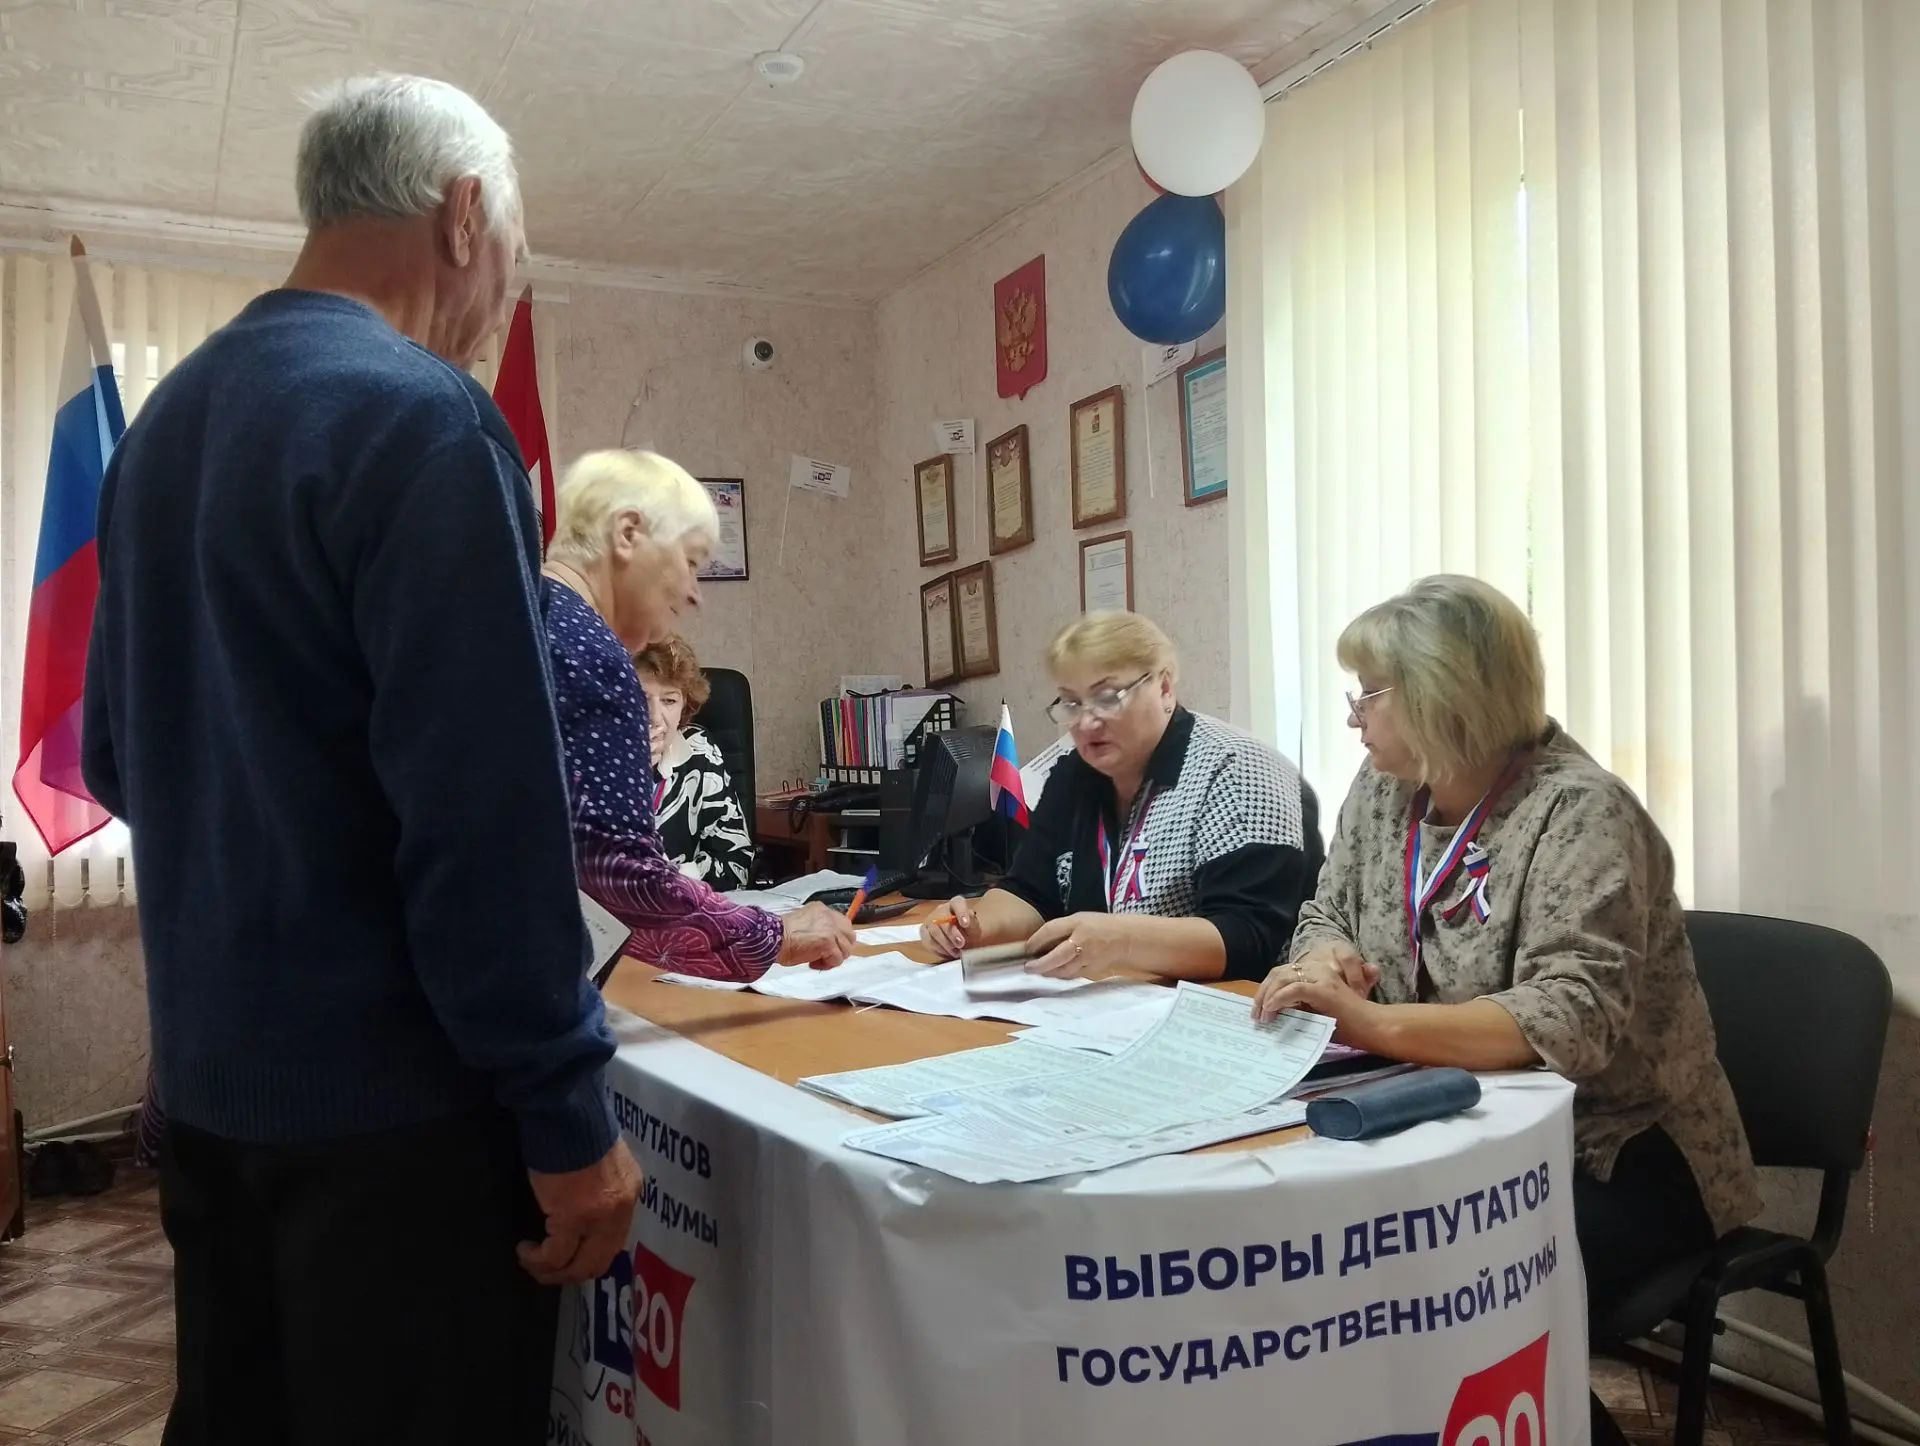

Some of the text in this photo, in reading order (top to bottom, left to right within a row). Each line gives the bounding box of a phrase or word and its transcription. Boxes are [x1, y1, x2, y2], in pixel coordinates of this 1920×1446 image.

[613, 1090, 712, 1179] ДЕПУТАТОВ
[660, 1191, 719, 1248] ДУМЫ
[1064, 1160, 1551, 1301] ВЫБОРЫ ДЕПУТАТОВ
[1056, 1236, 1558, 1387] ГОСУДАРСТВЕННОЙ ДУМЫ
